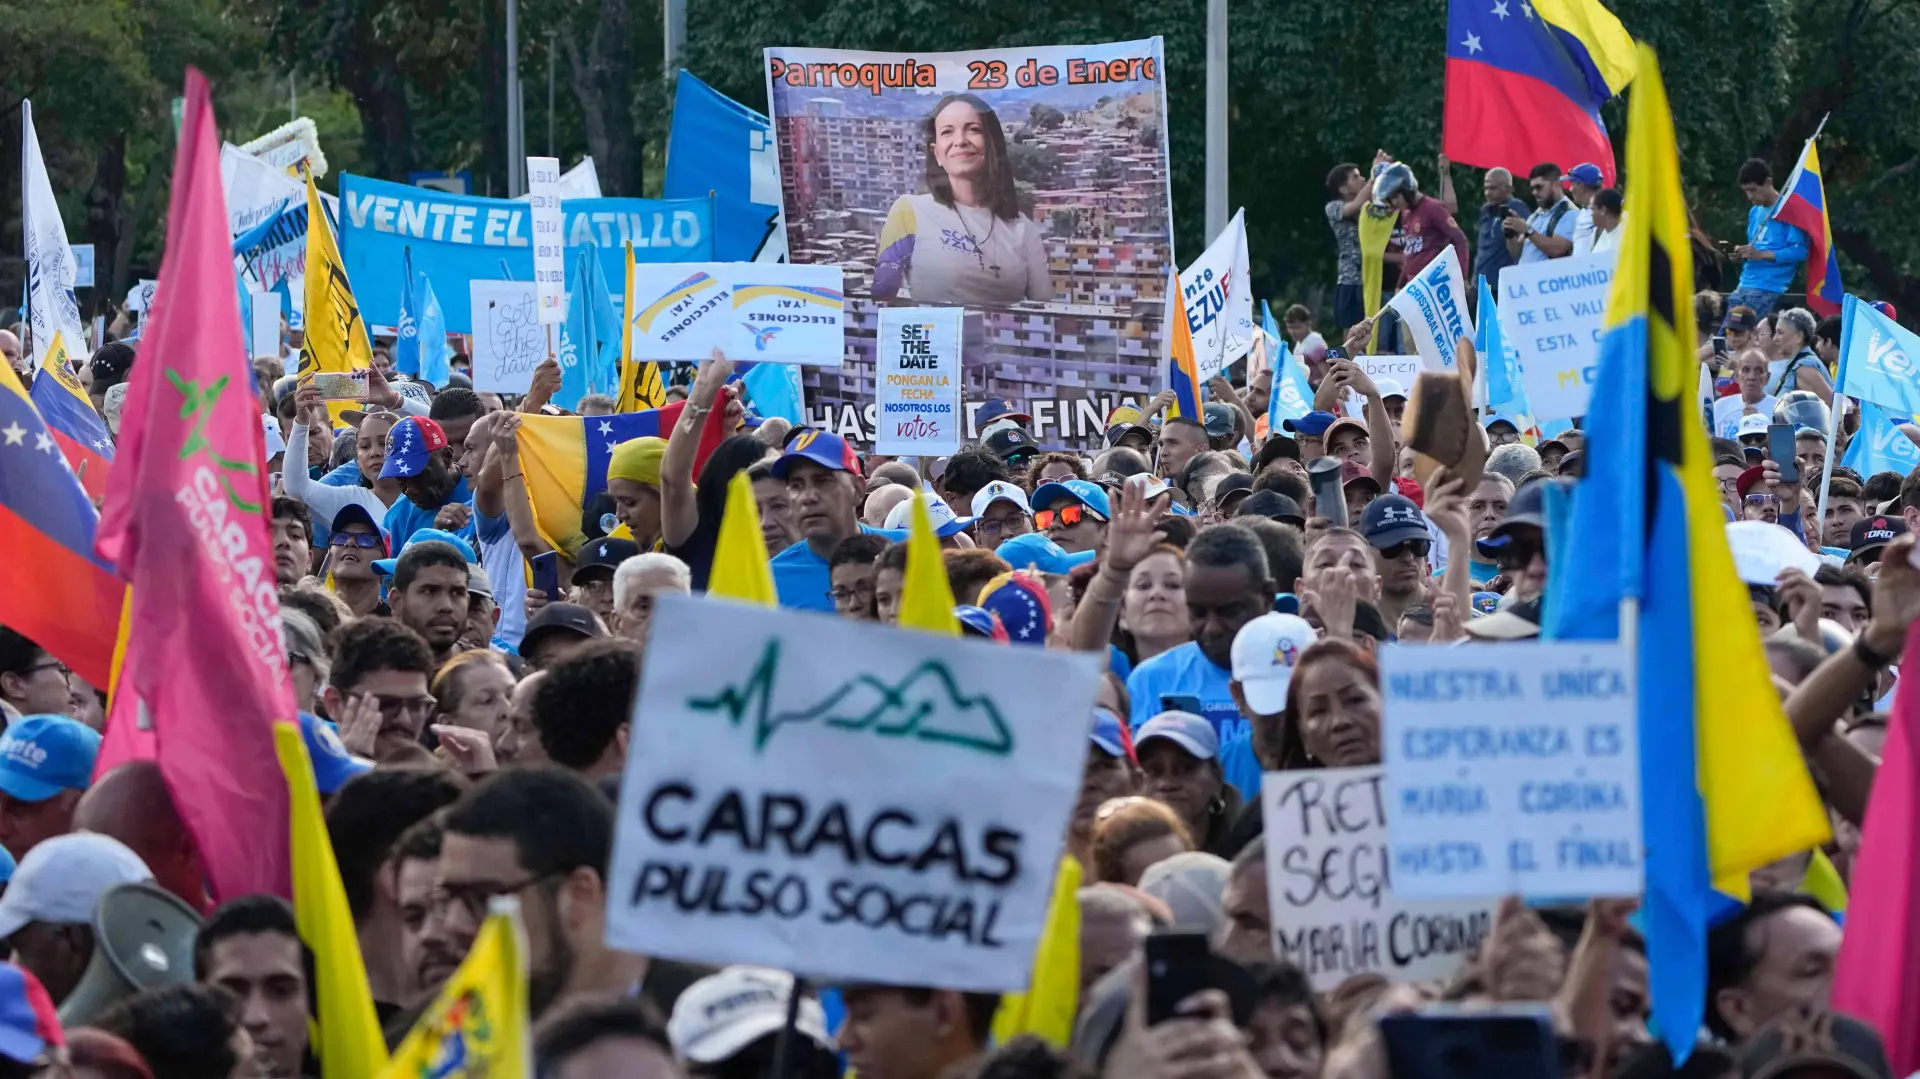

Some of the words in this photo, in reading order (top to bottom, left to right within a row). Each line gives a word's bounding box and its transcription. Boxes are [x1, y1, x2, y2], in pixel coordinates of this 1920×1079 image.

[967, 60, 1007, 90] 23
[1015, 59, 1059, 88] de
[345, 190, 478, 245] VENTE
[484, 206, 529, 247] EL
[561, 209, 701, 249] ATILLO
[1508, 284, 1529, 300] LA
[1538, 264, 1613, 295] COMUNID
[777, 298, 807, 309] ¡YA!
[1186, 266, 1233, 335] EZUE
[660, 290, 731, 343] ELECCIONES
[748, 313, 836, 325] ELECCIONES
[1406, 284, 1439, 336] CRISTOBAL
[1434, 332, 1452, 366] ROJAS
[1518, 311, 1537, 326] DE
[1544, 307, 1563, 322] EL
[901, 323, 936, 341] SET
[901, 340, 931, 355] THE
[1536, 334, 1578, 352] ESTA
[899, 355, 939, 370] DATE
[886, 374, 934, 387] PONGAN
[936, 375, 950, 387] LA
[900, 388, 936, 400] FECHA
[884, 402, 933, 413] NOSOTROS
[934, 403, 951, 413] LOS
[1032, 396, 1139, 438] FIN
[896, 414, 941, 440] votos
[1376, 518, 1399, 527] UNDER
[1863, 530, 1894, 540] TORO
[642, 781, 1023, 888] CARACAS
[630, 861, 809, 919] PULSO
[821, 877, 1007, 949] SOCIAL
